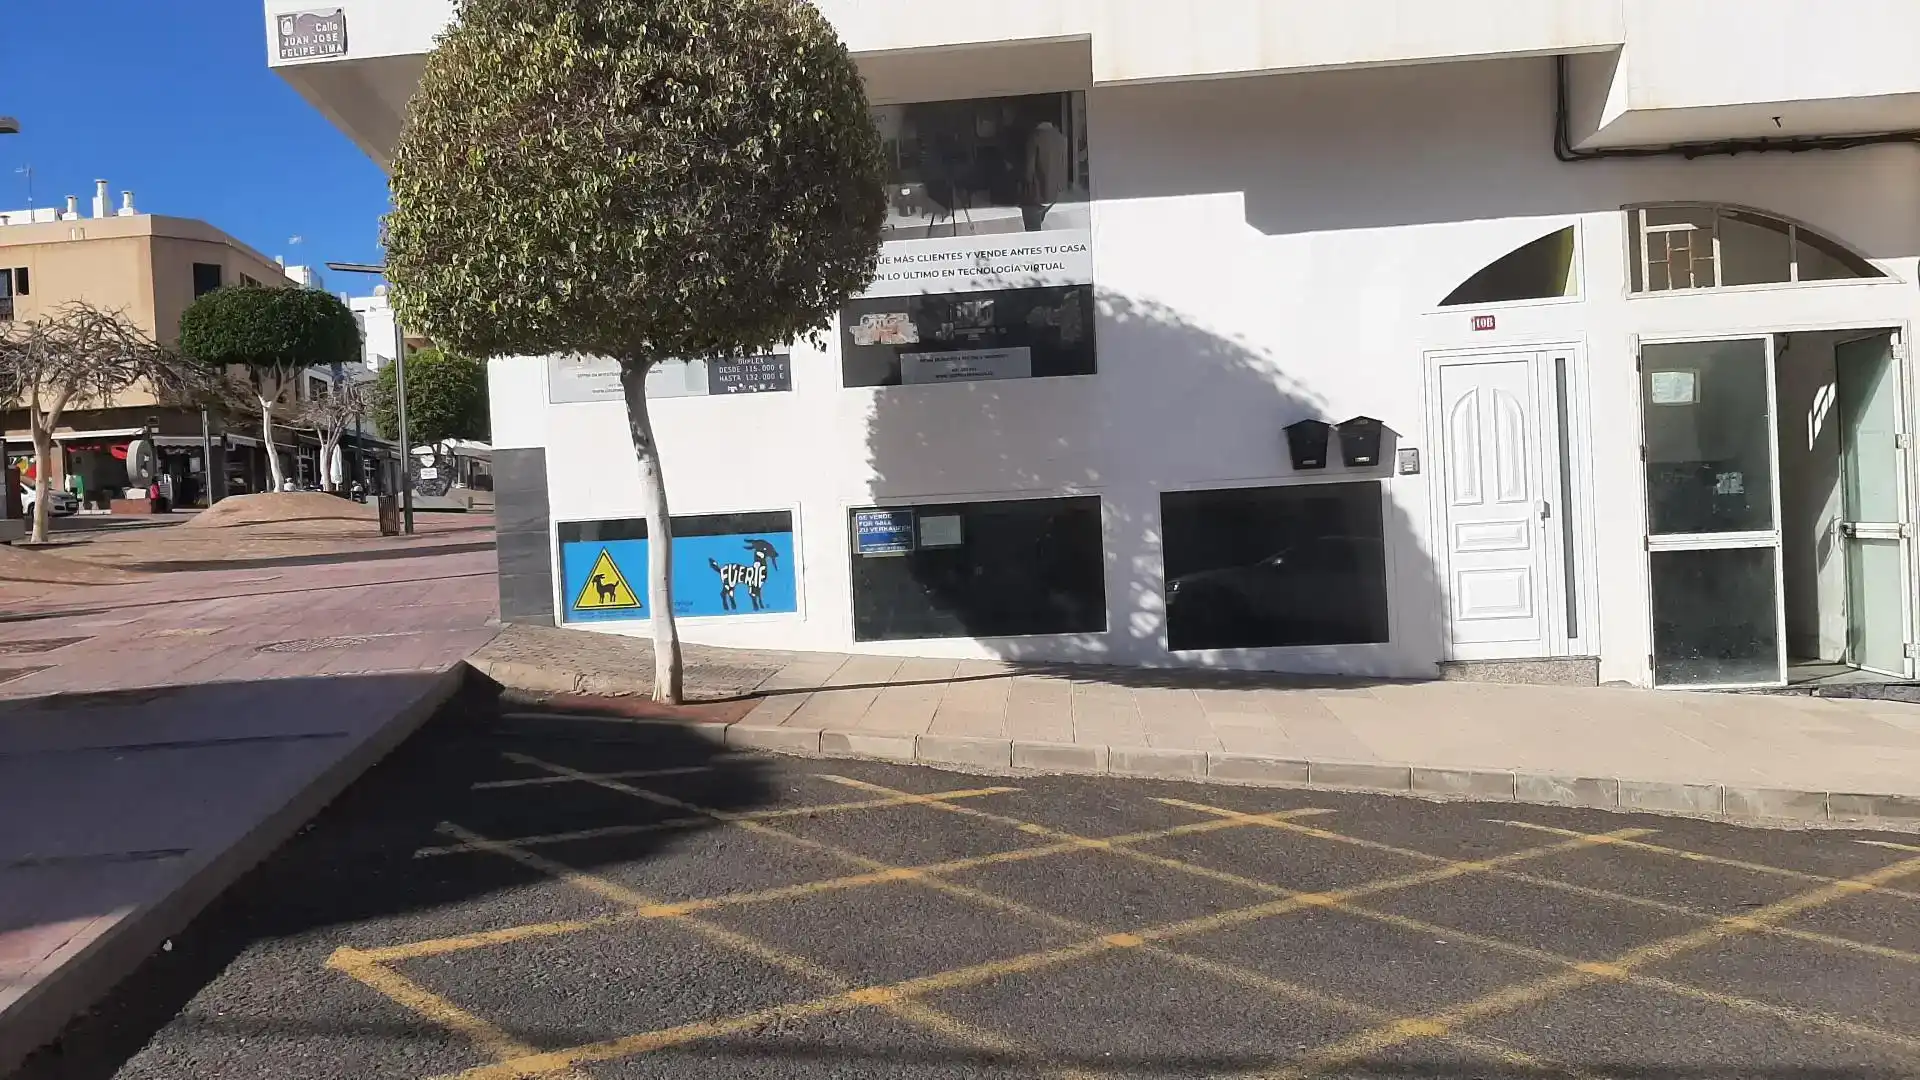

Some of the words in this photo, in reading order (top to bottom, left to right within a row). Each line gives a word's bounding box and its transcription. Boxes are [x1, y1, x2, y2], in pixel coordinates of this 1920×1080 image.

[315, 22, 338, 32] Calle
[284, 35, 309, 47] JUAN
[281, 46, 315, 57] FELIPE
[319, 43, 344, 54] LIMA
[893, 254, 915, 264] MÁS
[917, 252, 963, 263] CLIENTES
[965, 252, 972, 260] Y
[973, 249, 1008, 260] VENDE
[1009, 247, 1043, 256] ANTES
[1045, 246, 1058, 254] TU
[1060, 243, 1087, 253] CASA
[888, 272, 901, 280] LO
[903, 269, 939, 280] ÚLTIMO
[941, 269, 955, 278] EN
[957, 264, 1021, 277] TECNOLOGÍA
[1022, 261, 1066, 273] VIRTUAL
[1476, 317, 1493, 328] 10B
[718, 366, 742, 375] DESDE
[745, 364, 775, 373] 115.000
[718, 374, 742, 383] HASTA
[745, 373, 776, 382] 132.000
